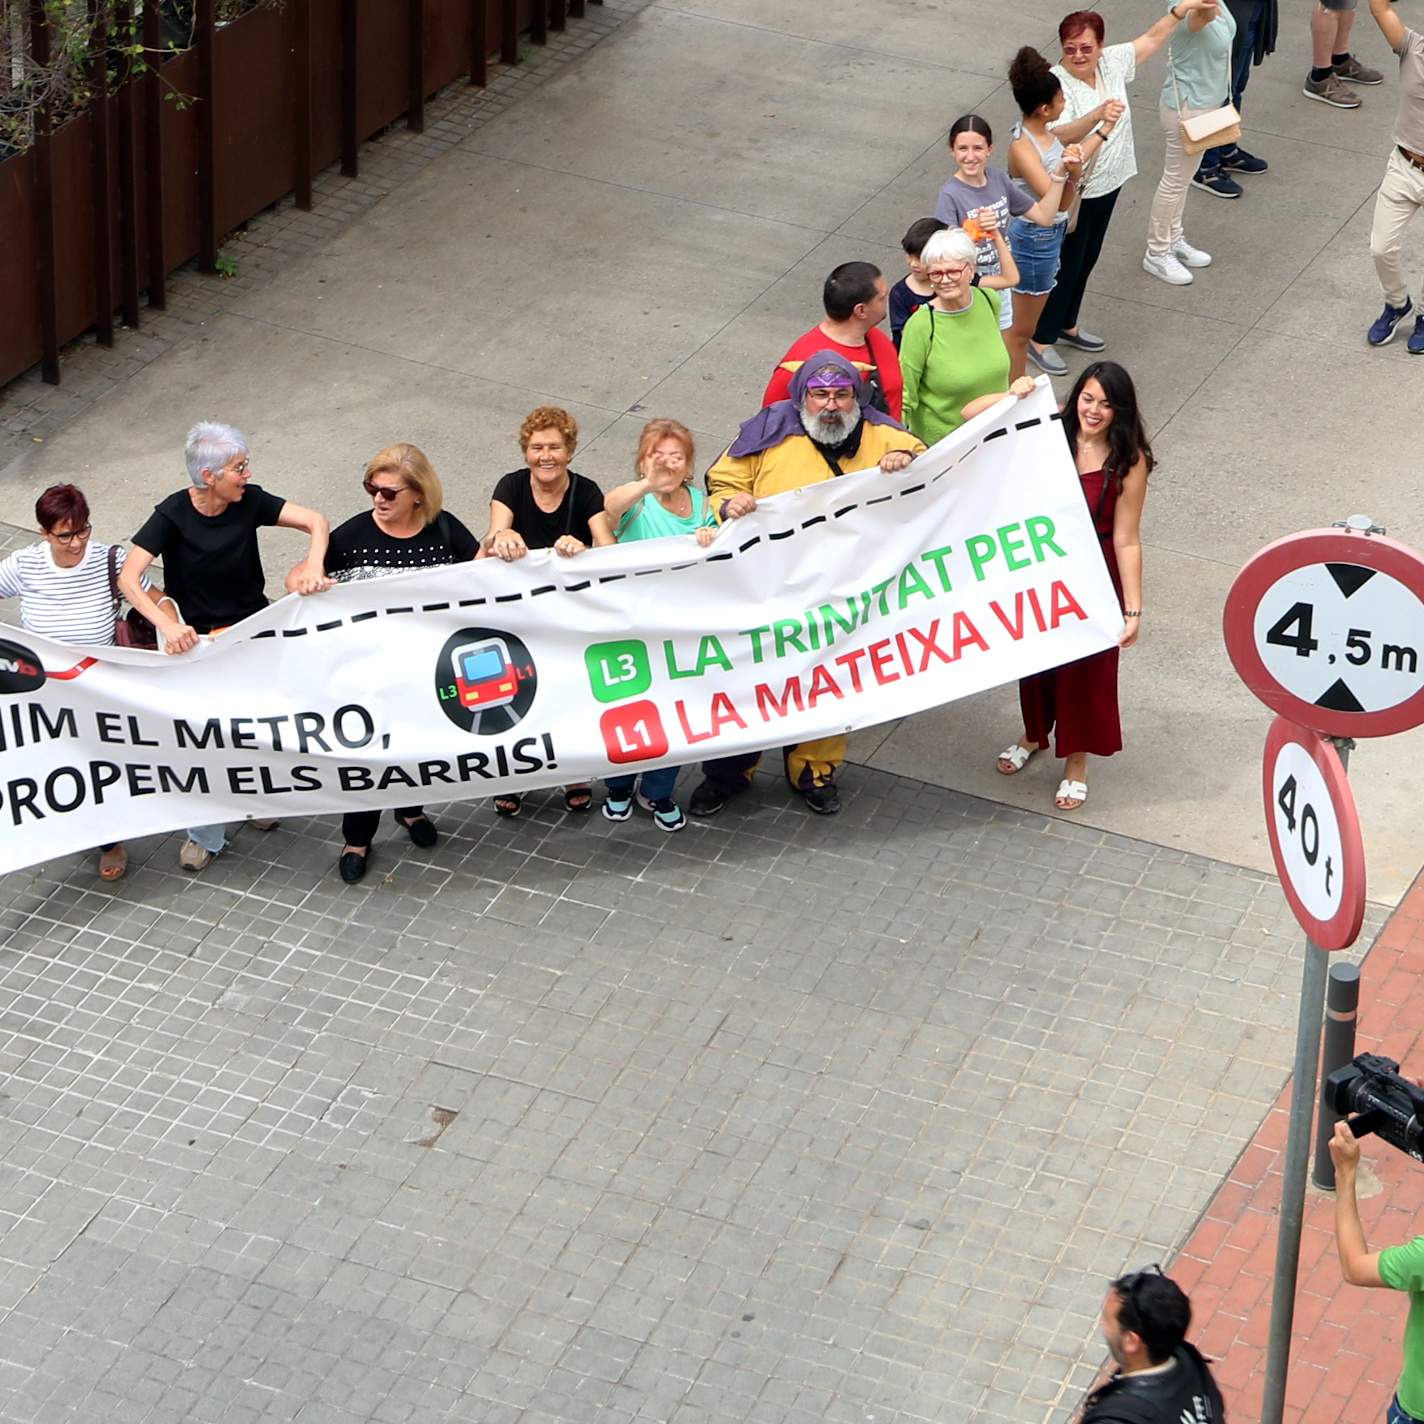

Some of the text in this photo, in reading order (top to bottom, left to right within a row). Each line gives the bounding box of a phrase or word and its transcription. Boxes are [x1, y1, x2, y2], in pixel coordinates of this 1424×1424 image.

[600, 515, 1068, 687] L3 LA TRINITAT PER
[439, 685, 458, 702] L3
[516, 664, 534, 680] L1
[616, 579, 1088, 754] L1 LA MATEIXA VIA
[95, 712, 159, 747] EL
[173, 704, 392, 754] METRO,
[228, 765, 323, 795] ELS
[338, 733, 559, 793] BARRIS!
